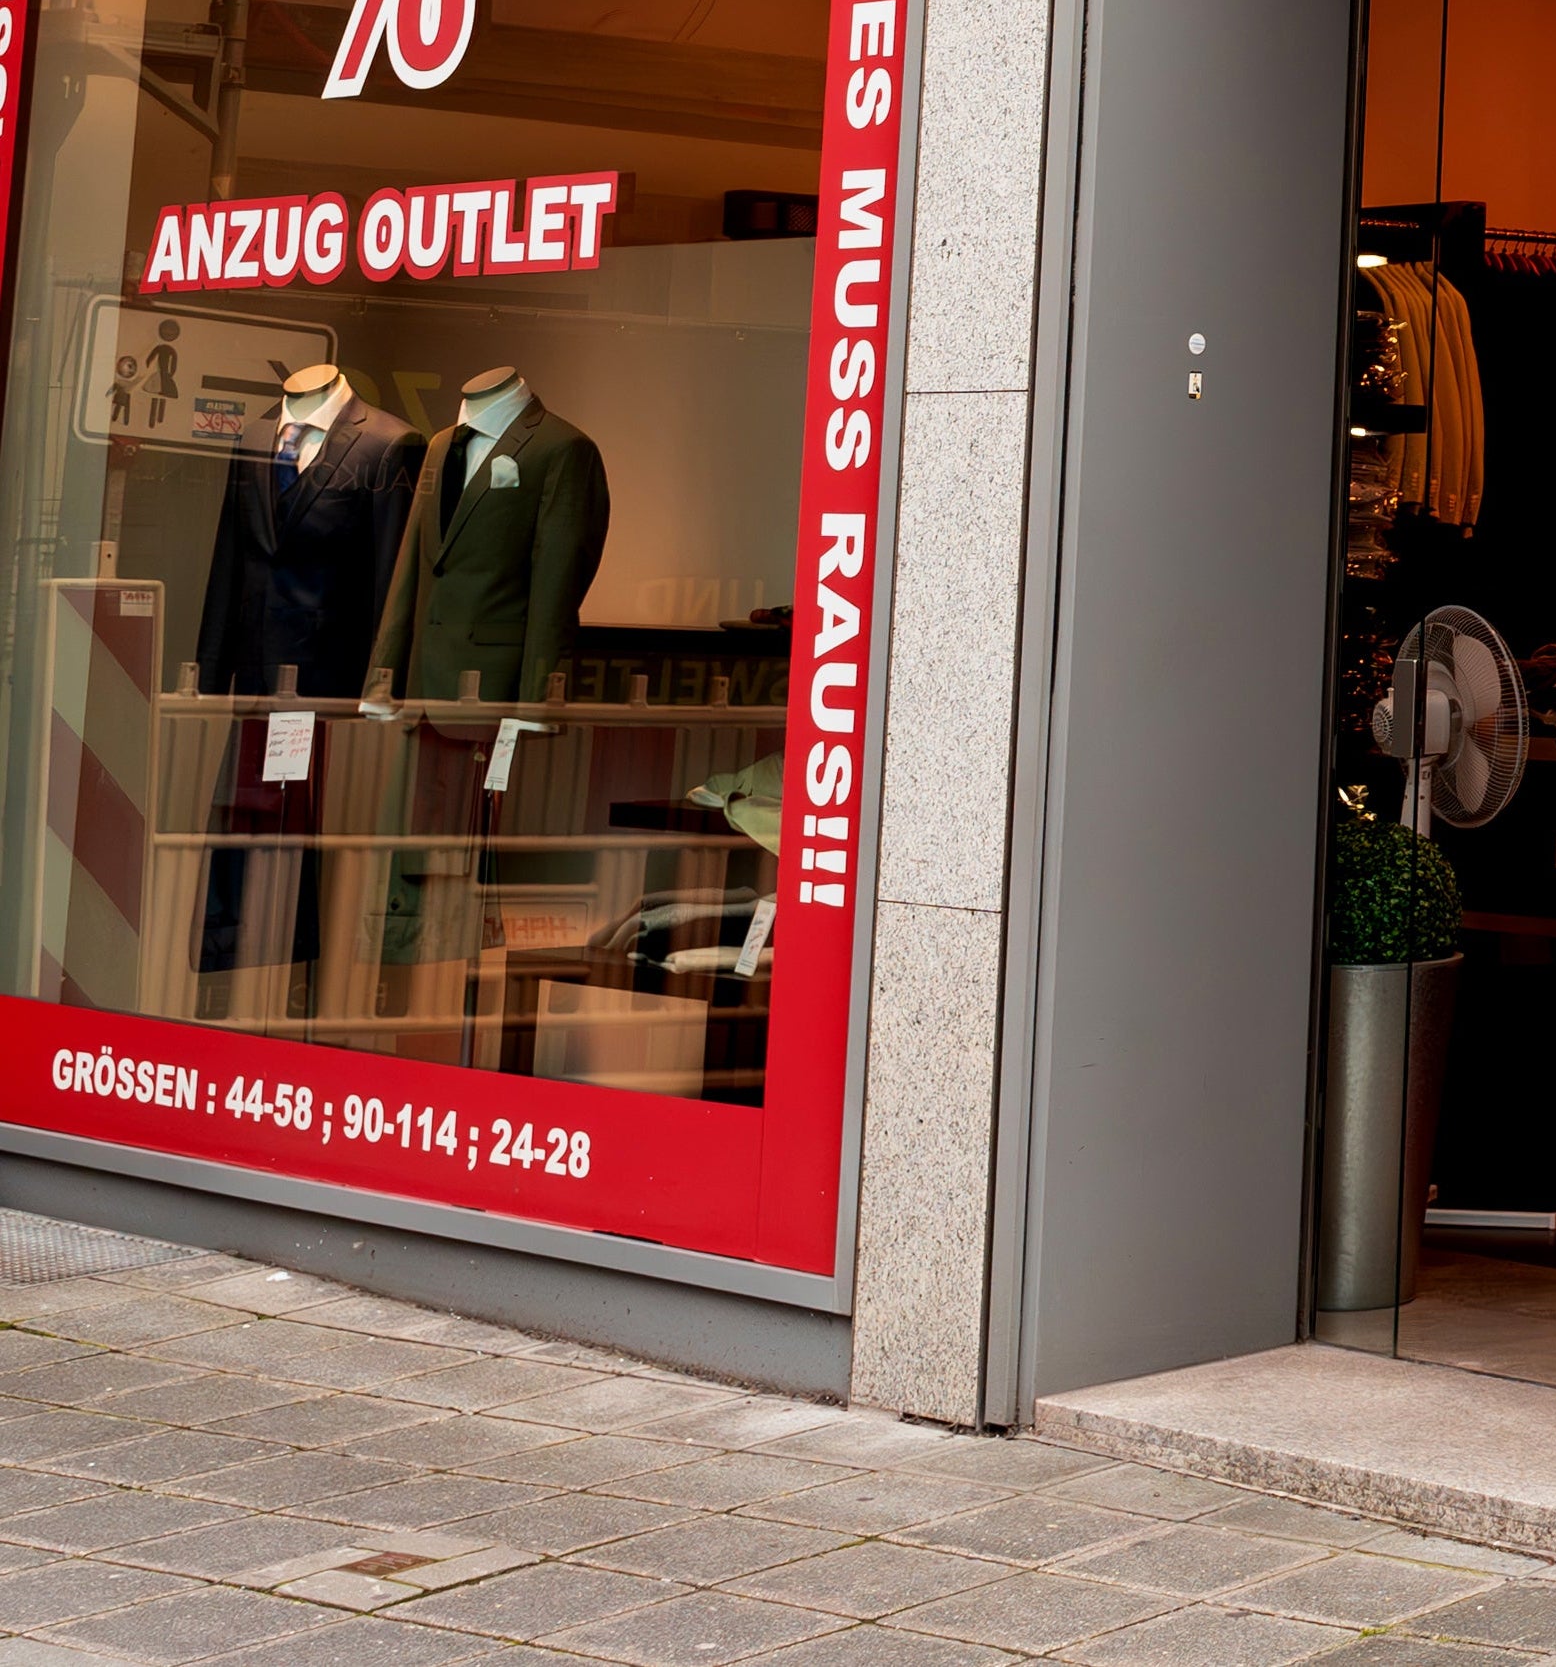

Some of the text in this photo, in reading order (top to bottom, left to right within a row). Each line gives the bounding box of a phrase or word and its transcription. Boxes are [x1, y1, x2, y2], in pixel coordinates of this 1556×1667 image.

[147, 182, 612, 283] ANZUG OUTLET
[825, 168, 886, 471] MUSS
[800, 513, 866, 907] RAUS!!!
[53, 1049, 198, 1111] GRÖSSEN
[226, 1076, 313, 1131] 44-58
[343, 1094, 458, 1156] 90-114
[489, 1118, 591, 1179] 24-28
